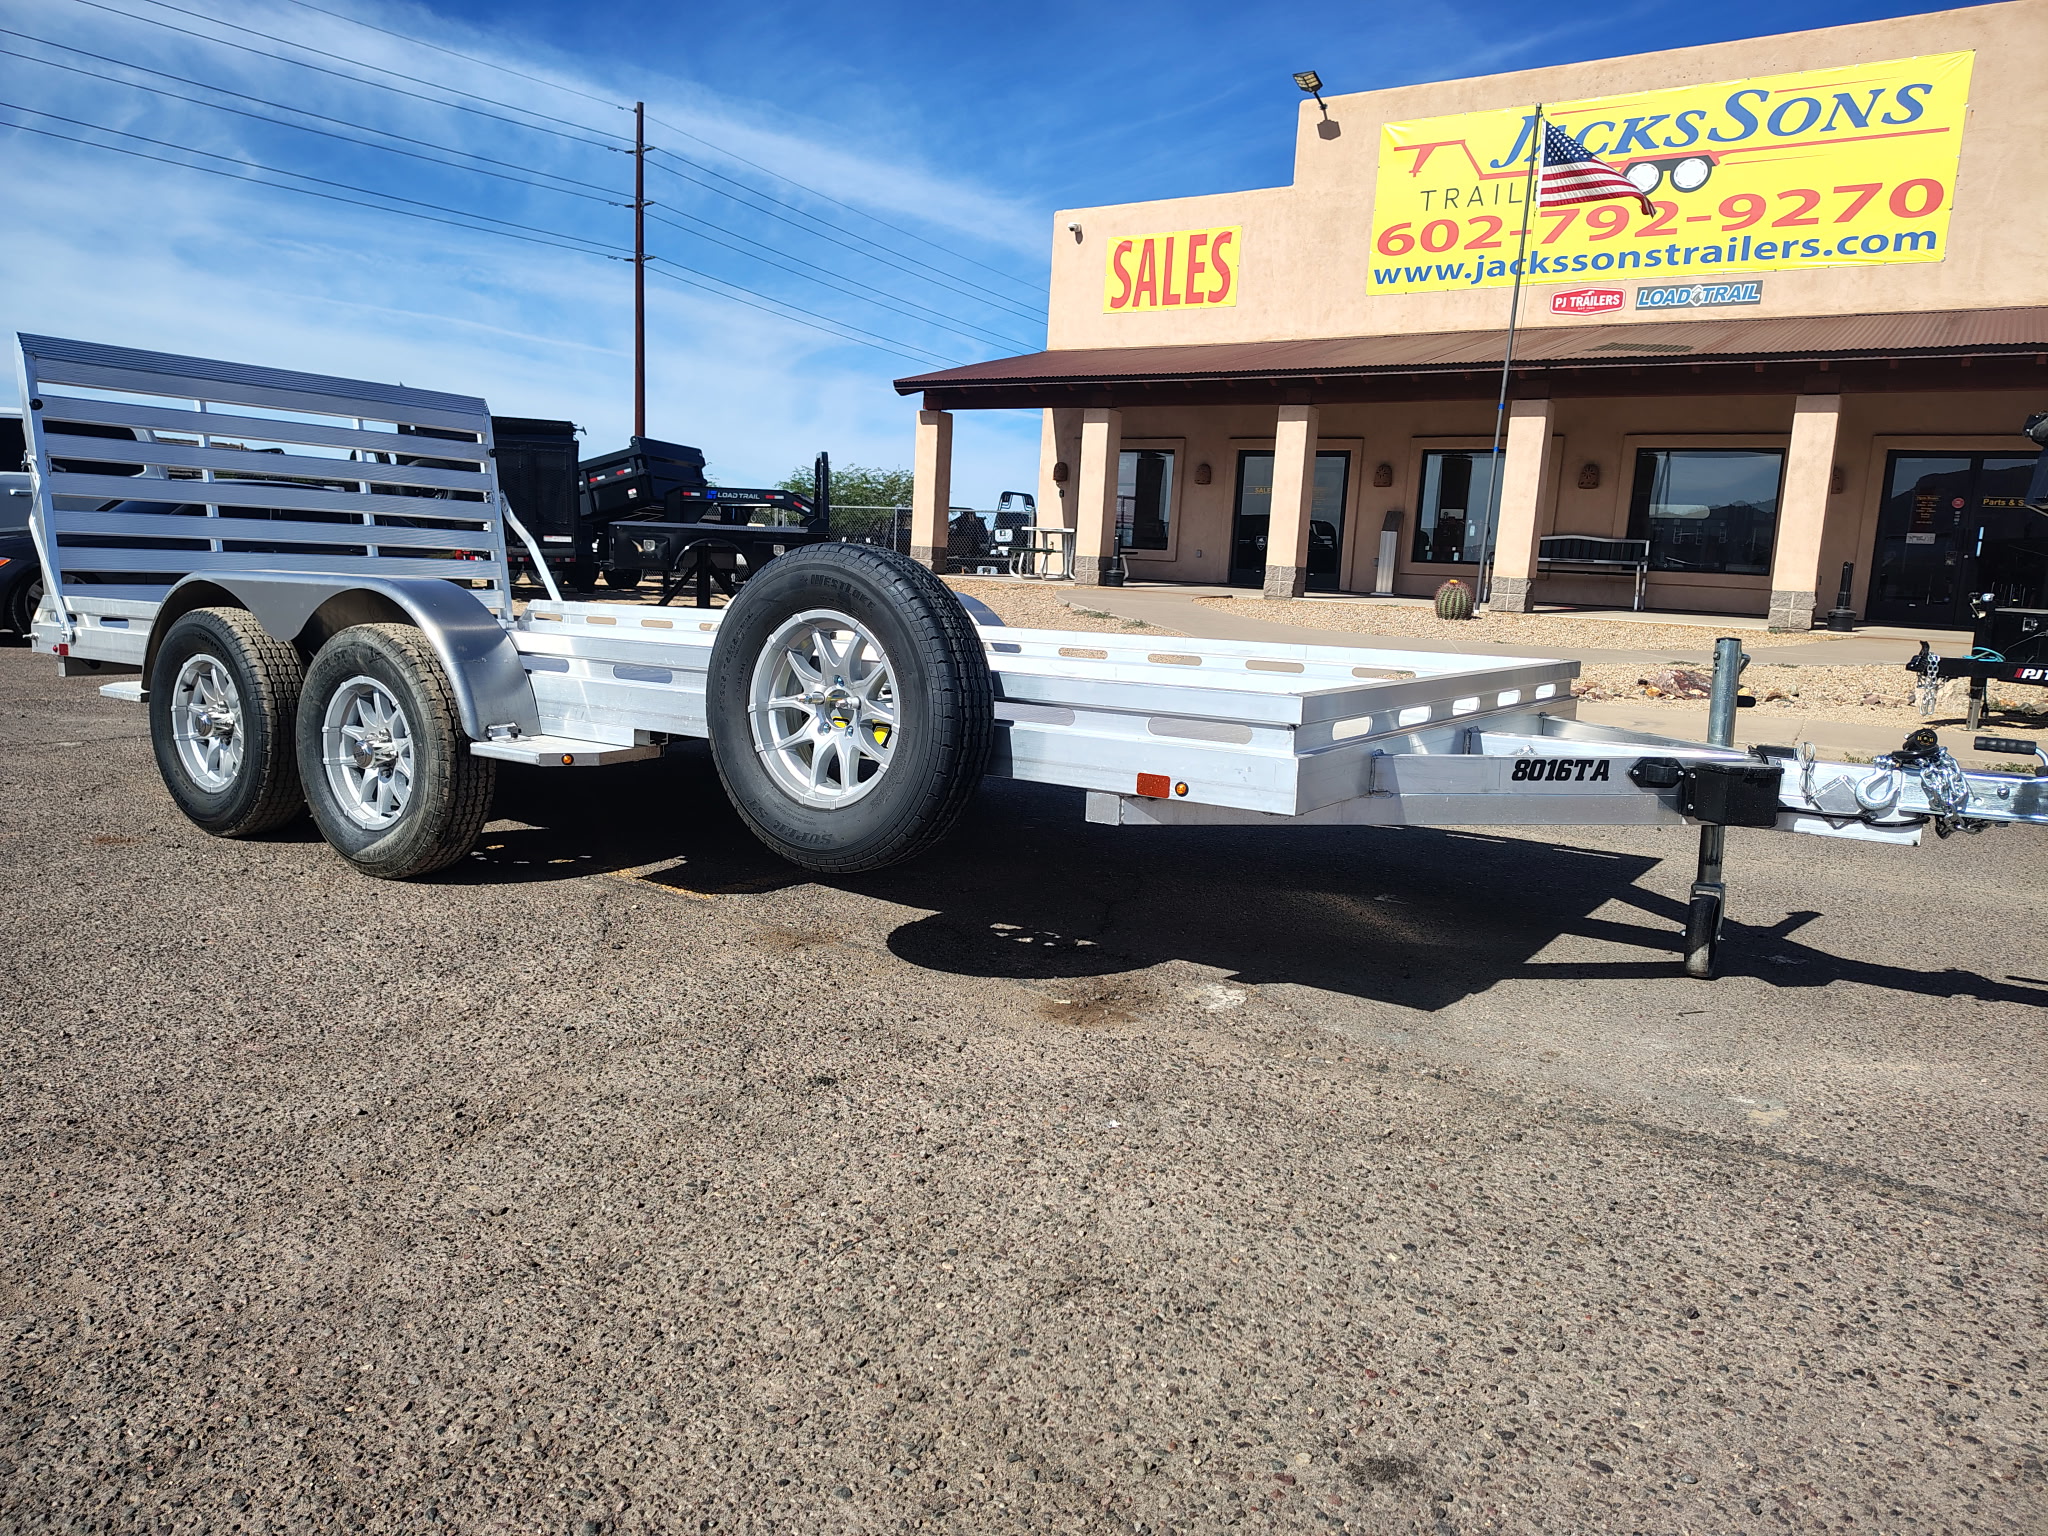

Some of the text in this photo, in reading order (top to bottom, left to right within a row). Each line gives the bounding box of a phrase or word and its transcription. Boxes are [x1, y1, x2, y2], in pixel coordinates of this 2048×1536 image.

[1489, 83, 1933, 169] JCKSSONS
[1377, 178, 1945, 257] 602-792-9270
[1110, 231, 1233, 309] SALES
[1373, 230, 1937, 285] www.jackssonstrailers.com
[1554, 294, 1621, 308] PJ TRAILERS
[1637, 284, 1760, 307] LOAD TRAIL
[1983, 498, 2006, 506] Parts
[2008, 499, 2016, 507] &
[2021, 668, 2044, 680] PJ
[1511, 759, 1610, 782] 8016TA
[771, 819, 833, 847] SUPER
